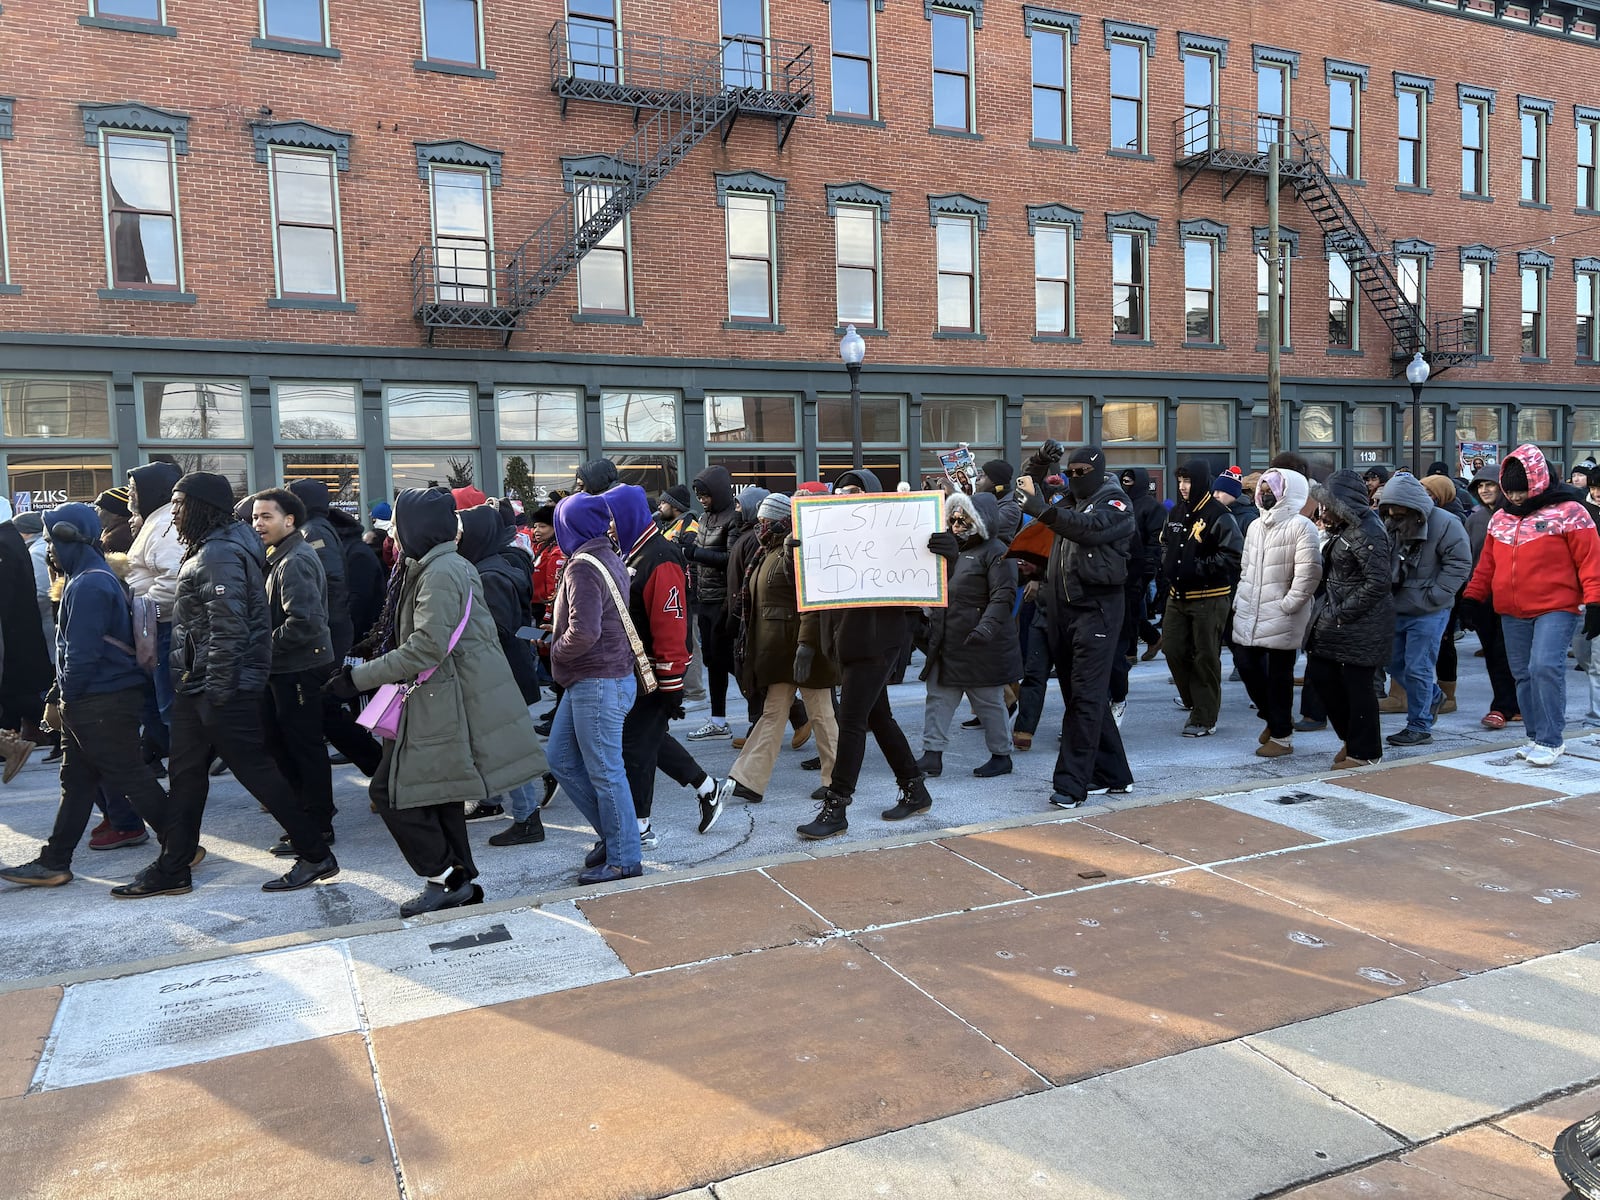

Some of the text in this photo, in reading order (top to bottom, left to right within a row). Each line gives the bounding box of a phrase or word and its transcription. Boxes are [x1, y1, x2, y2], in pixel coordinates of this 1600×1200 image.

[1360, 451, 1376, 462] 1130
[33, 490, 68, 503] ZIKS
[807, 501, 930, 538] I STILL
[894, 536, 917, 561] A
[663, 586, 684, 619] 4
[389, 960, 436, 973] JOHN
[159, 978, 206, 994] Bob
